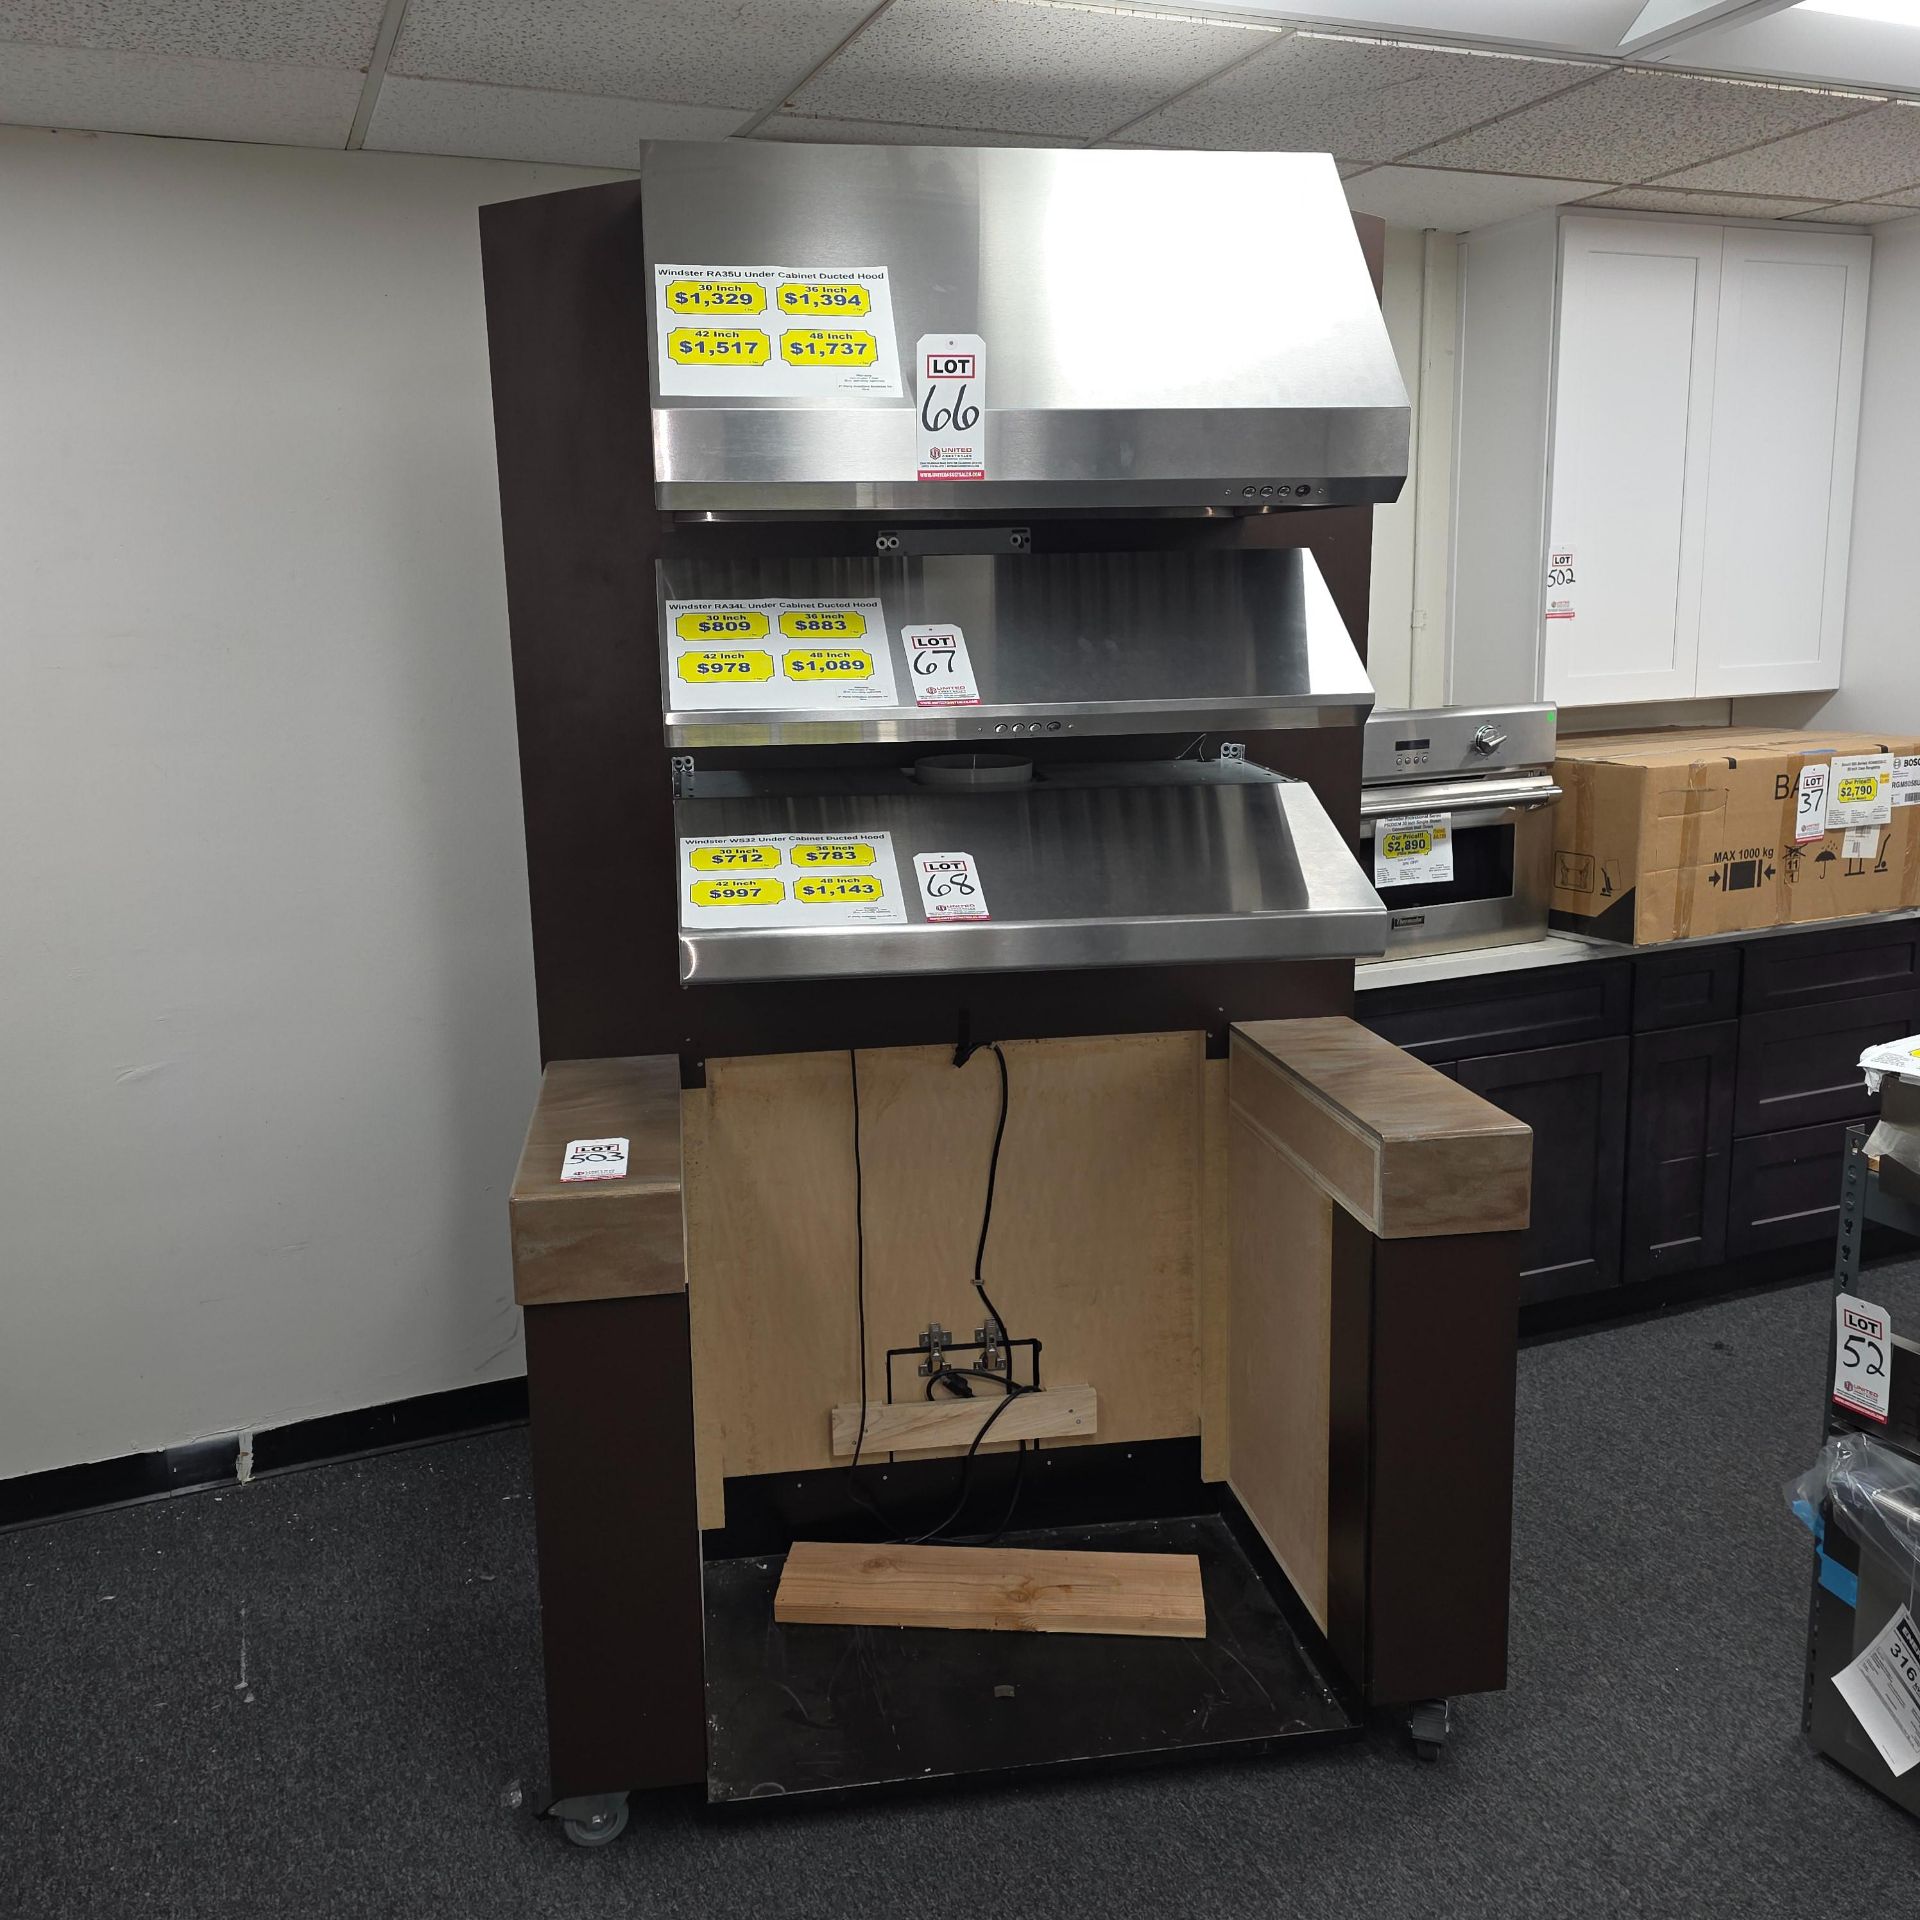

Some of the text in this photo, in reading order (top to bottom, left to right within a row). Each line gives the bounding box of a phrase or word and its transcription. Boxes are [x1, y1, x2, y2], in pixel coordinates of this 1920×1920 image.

[658, 269, 704, 277] Windster
[706, 270, 741, 278] RA35U
[778, 271, 816, 279] Cabinet
[675, 291, 753, 307] $1,329
[784, 292, 861, 307] $1,394
[679, 340, 758, 356] $1,517
[790, 342, 867, 357] $1,737
[933, 359, 970, 374] LOT
[922, 384, 980, 431] 66
[1555, 556, 1570, 564] LOT
[1547, 568, 1576, 588] 502
[698, 621, 751, 632] $809
[795, 620, 847, 631] $883
[917, 637, 950, 646] LOT
[697, 662, 751, 674] $978
[792, 660, 865, 672] $1,089
[913, 650, 956, 675] 67
[1805, 777, 1821, 786] LOT
[1840, 785, 1872, 797] $2,790
[1799, 789, 1824, 814] 37
[1387, 839, 1426, 853] $2,890
[711, 854, 764, 864] $712
[806, 852, 857, 861] $783
[1714, 847, 1774, 863] MAX 1000 kg
[929, 863, 961, 871] LOT
[802, 884, 875, 896] $1,143
[927, 873, 975, 897] 68
[709, 888, 762, 899] $997
[565, 1152, 625, 1164] 503
[1848, 1314, 1878, 1334] LOT
[1843, 1335, 1885, 1377] 52
[1890, 1643, 1918, 1683] 316
